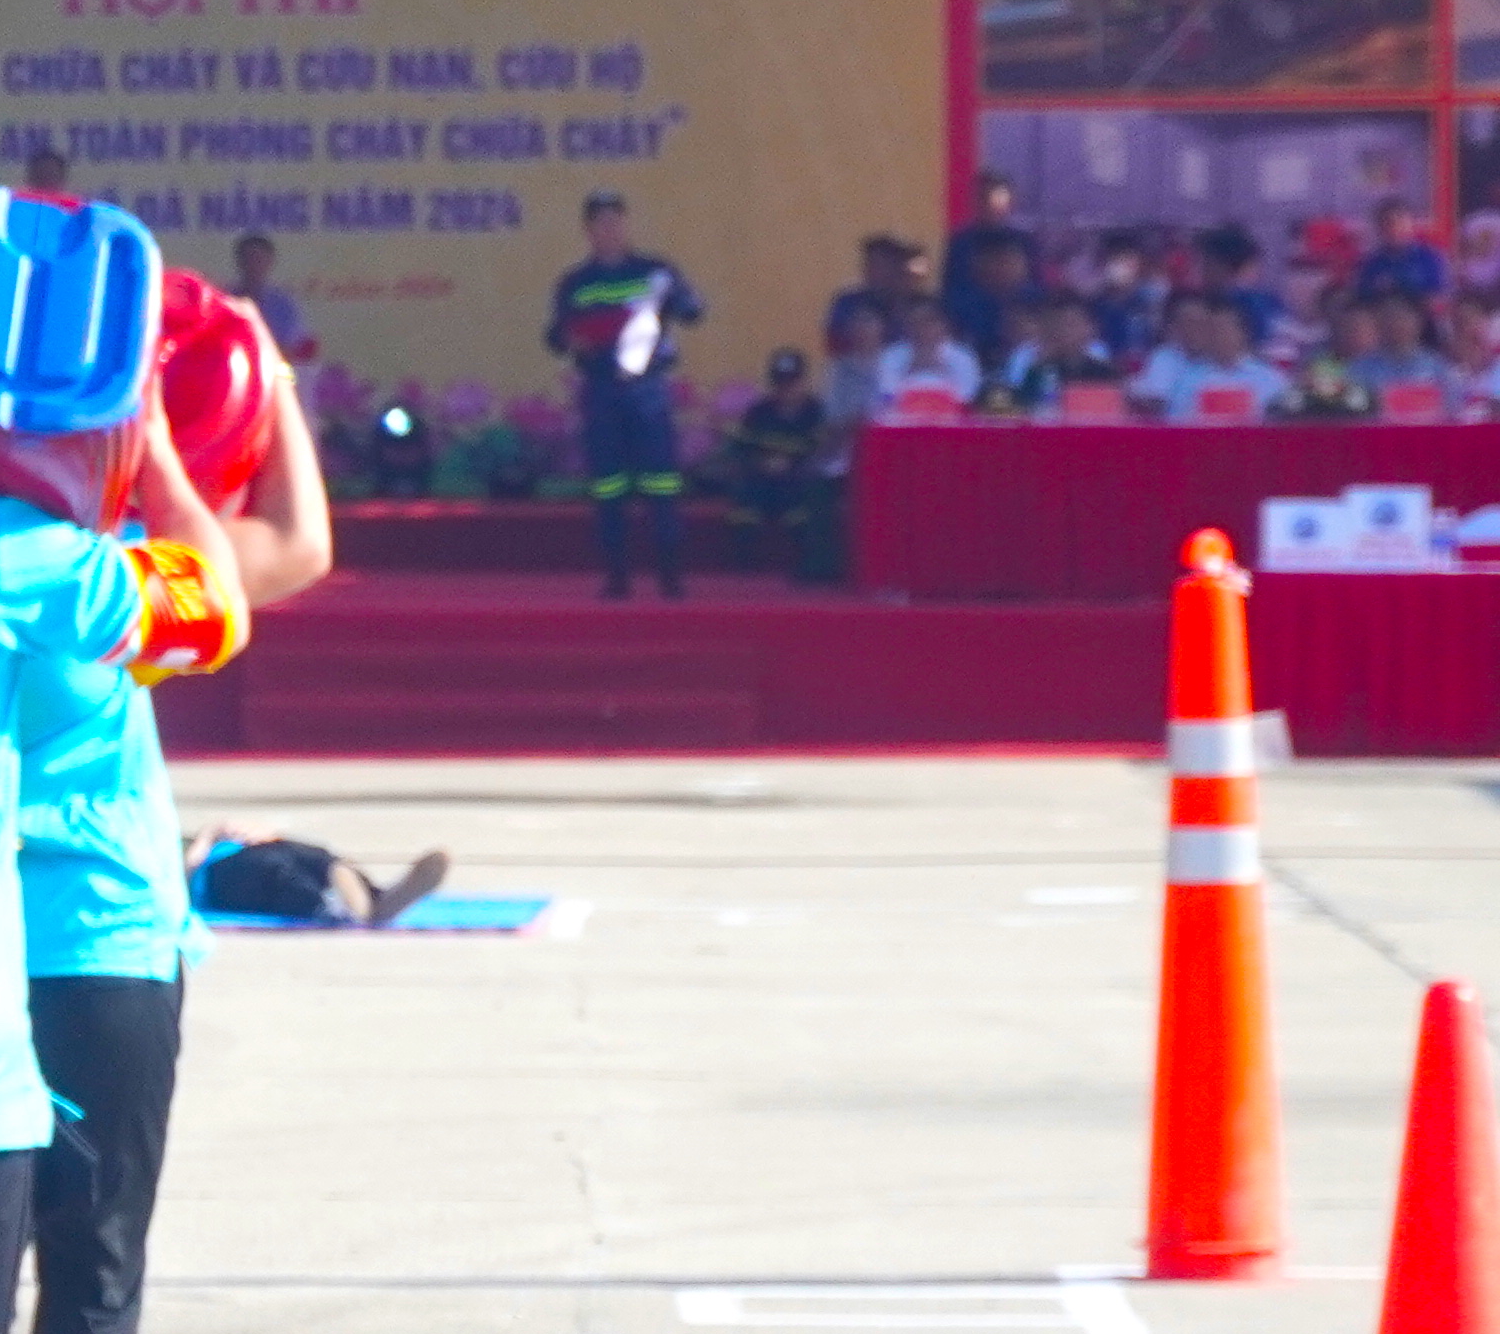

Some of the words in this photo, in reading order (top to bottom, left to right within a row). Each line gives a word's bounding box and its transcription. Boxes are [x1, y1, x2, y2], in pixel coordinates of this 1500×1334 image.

[3, 44, 106, 94] CHỮA
[119, 45, 219, 93] CHÁY
[233, 45, 283, 92] VÀ
[67, 116, 168, 162] TOÀN
[180, 116, 312, 161] PHÒNG
[327, 116, 428, 161] CHÁY
[428, 190, 522, 230] 2024
